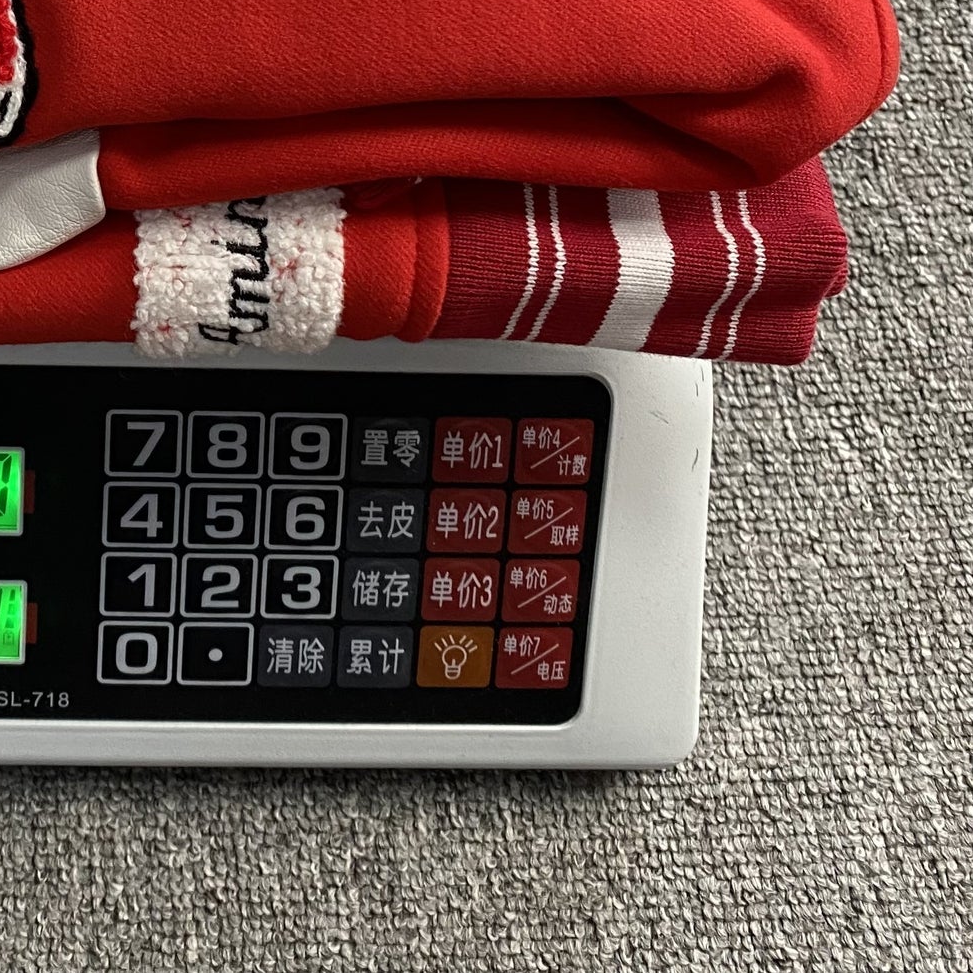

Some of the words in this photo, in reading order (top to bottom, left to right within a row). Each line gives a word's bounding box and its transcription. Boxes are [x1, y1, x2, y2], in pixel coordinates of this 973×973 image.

[127, 421, 166, 467] 7
[207, 423, 248, 469] 8
[289, 424, 331, 470] 9
[360, 429, 421, 468] 置零
[440, 431, 503, 469] 单价1
[522, 426, 560, 449] 单价4
[557, 454, 587, 476] 计数
[120, 493, 163, 537] 4
[204, 494, 244, 539] 5
[285, 495, 326, 540] 6
[357, 501, 415, 539] 去皮
[435, 501, 499, 540] 单价2
[516, 497, 554, 521] 单价5
[550, 525, 579, 546] 取样
[127, 563, 156, 607] 1
[201, 564, 241, 608] 2
[281, 565, 321, 610] 3
[352, 570, 411, 608] 储存
[430, 571, 492, 609] 单价3
[510, 567, 547, 590] 单价6
[543, 594, 573, 615] 动态
[115, 631, 158, 675] 0
[266, 637, 325, 674] 清除
[346, 638, 405, 675] 累计
[503, 634, 541, 657] 单价7
[537, 661, 566, 682] 电压
